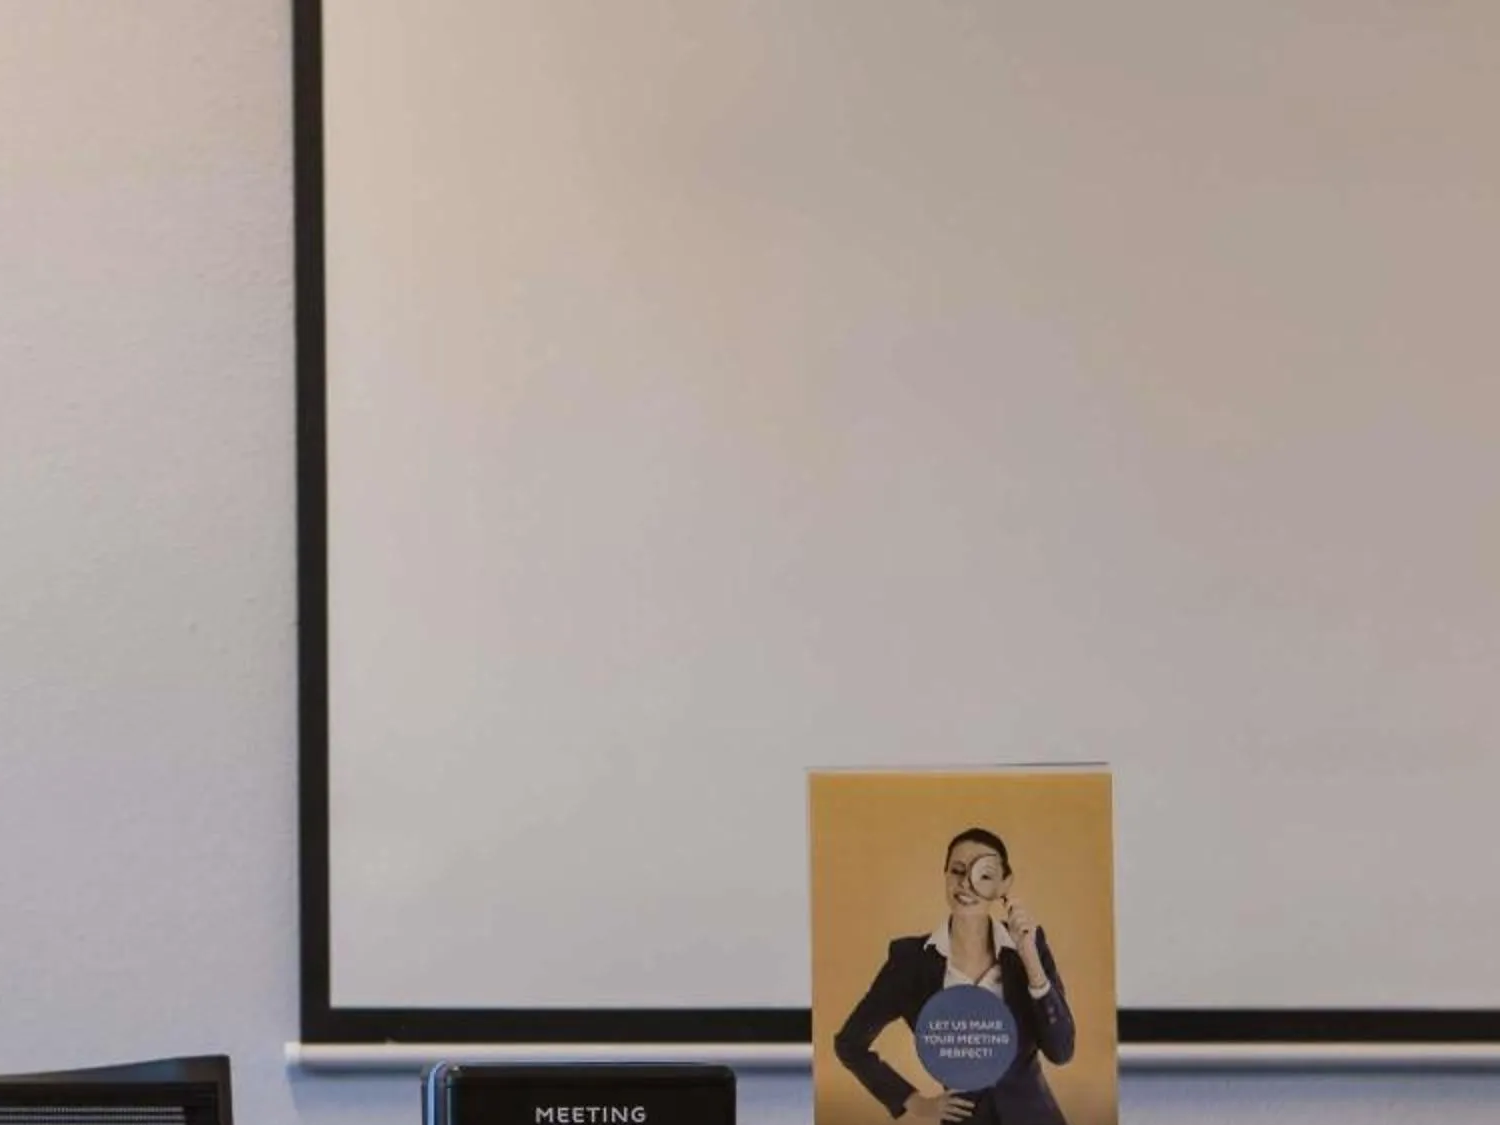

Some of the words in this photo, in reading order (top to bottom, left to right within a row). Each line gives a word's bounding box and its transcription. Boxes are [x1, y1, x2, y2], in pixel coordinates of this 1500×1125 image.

[928, 1020, 949, 1031] LET
[951, 1020, 967, 1031] US
[969, 1020, 1003, 1031] MAKE
[924, 1035, 955, 1046] YOUR
[956, 1034, 1010, 1046] MEETING
[535, 1105, 647, 1124] MEETING
